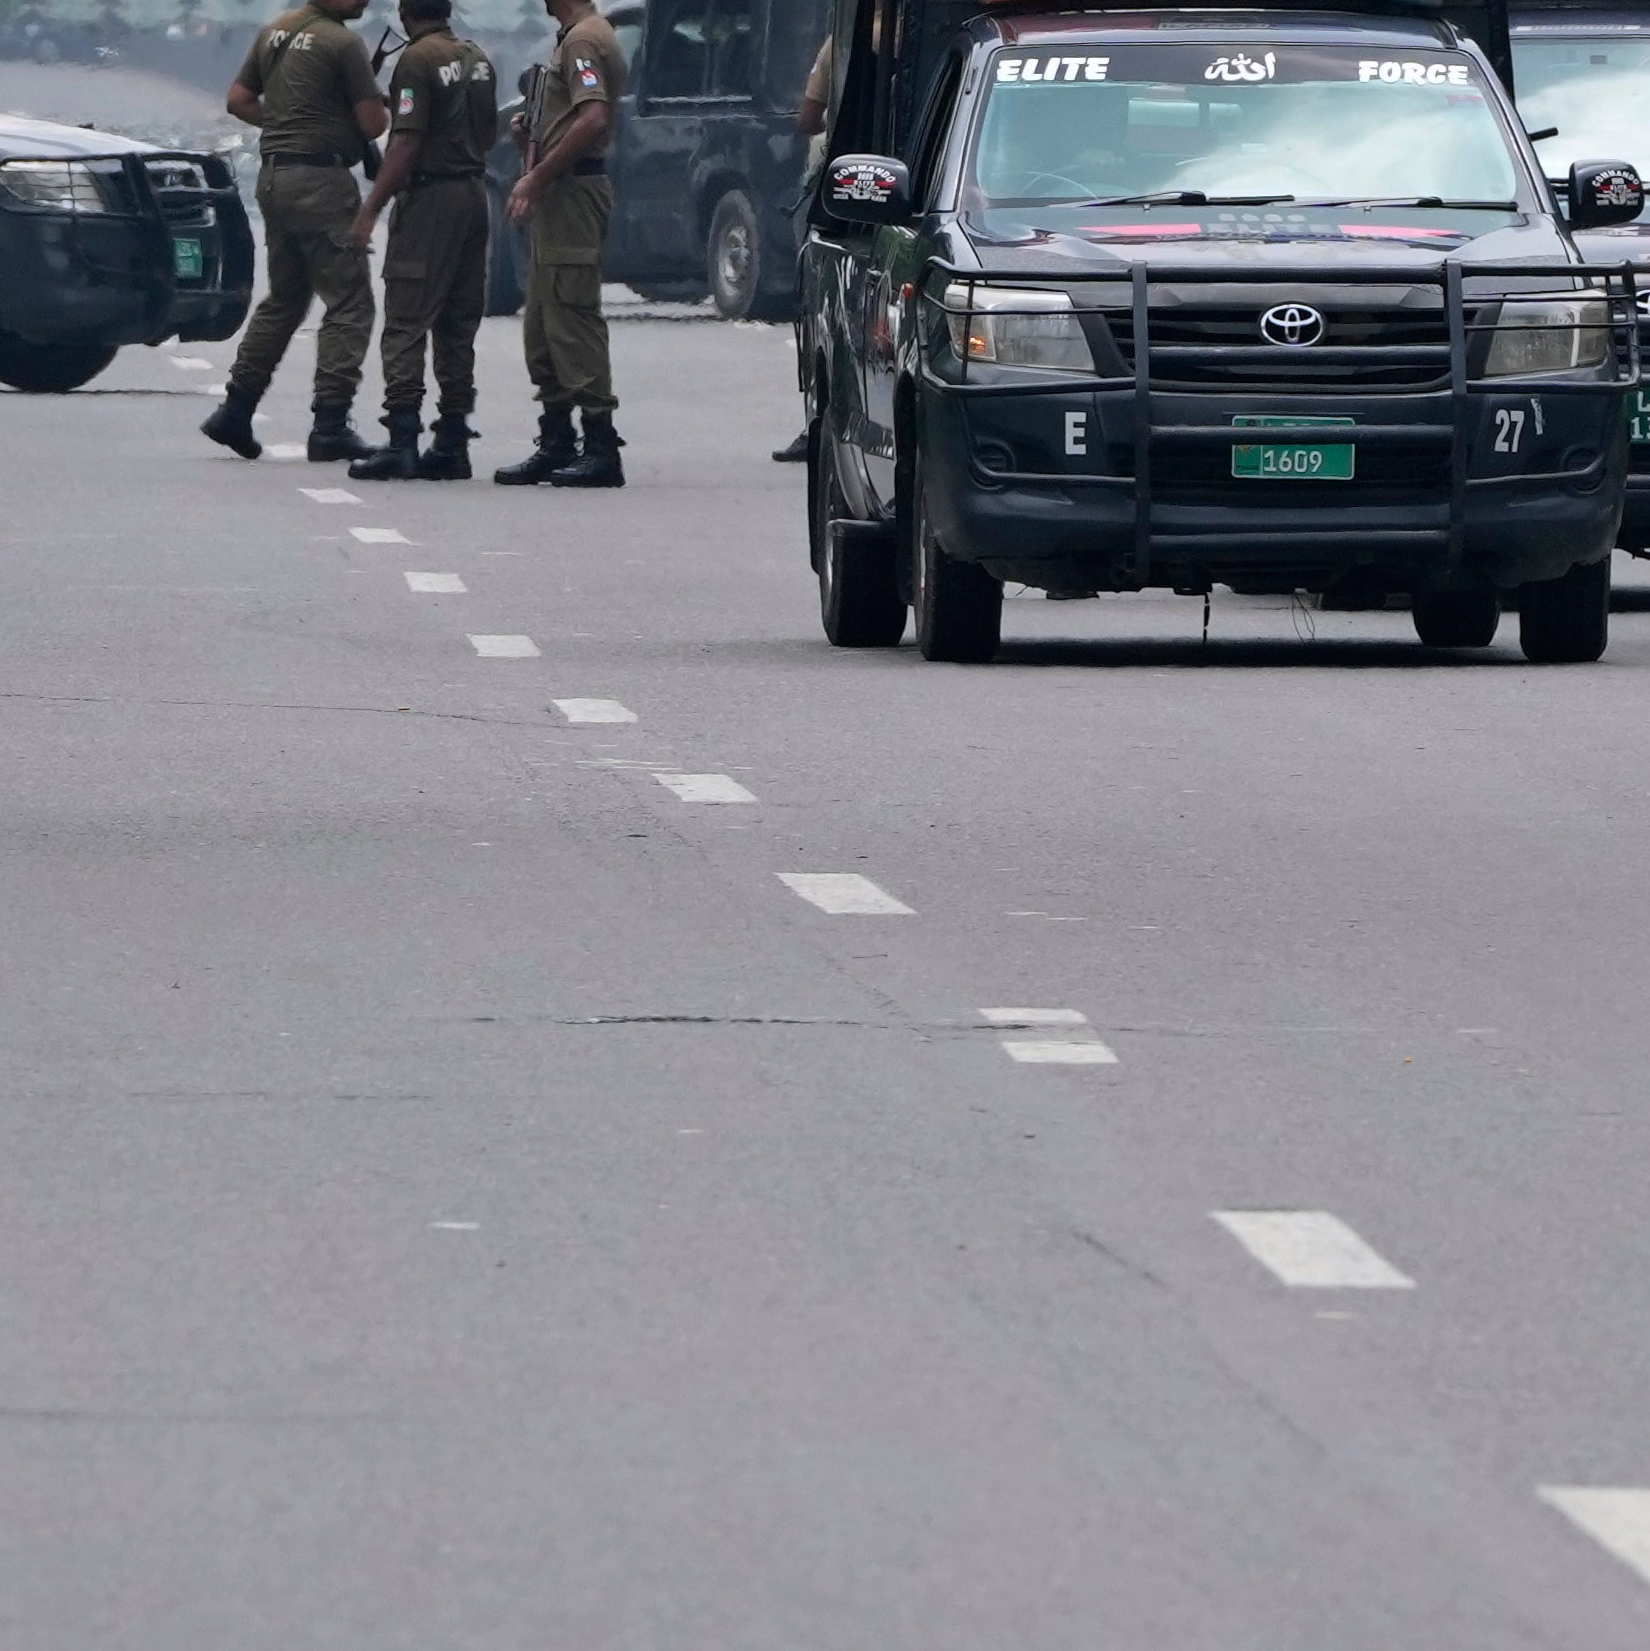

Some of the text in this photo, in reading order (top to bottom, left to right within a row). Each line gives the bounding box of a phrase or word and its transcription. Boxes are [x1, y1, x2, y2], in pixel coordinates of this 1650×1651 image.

[266, 29, 316, 51] POICE
[997, 56, 1468, 86] ELITE FORCE
[833, 165, 897, 183] COMMANDO
[1591, 169, 1640, 187] COMMANDO
[1064, 411, 1087, 455] E
[1494, 408, 1525, 453] 27
[1263, 449, 1323, 473] 1609
